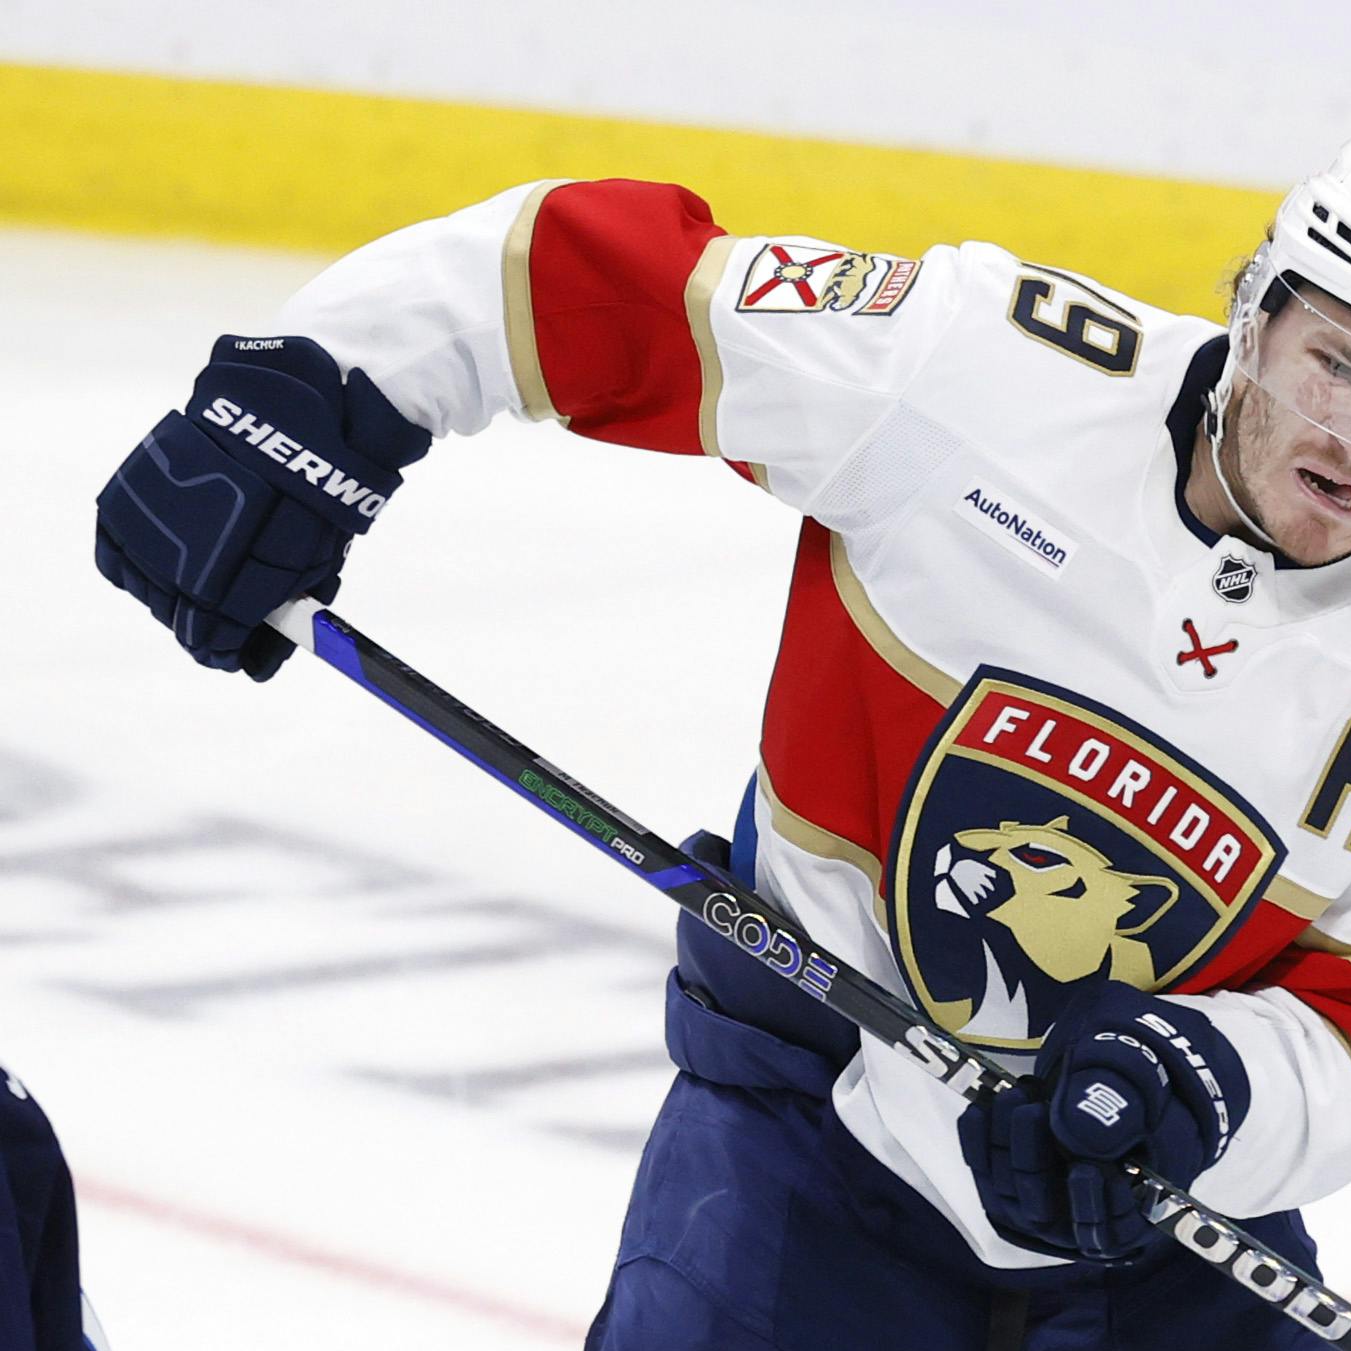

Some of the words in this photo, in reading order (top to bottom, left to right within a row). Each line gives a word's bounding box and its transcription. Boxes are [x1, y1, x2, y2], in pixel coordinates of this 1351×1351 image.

[1006, 260, 1142, 378] 9
[964, 488, 1067, 564] AutoNation
[1218, 572, 1249, 589] NHL
[518, 768, 618, 843] ENCRYPT
[610, 836, 646, 866] PRO
[982, 705, 1242, 884] FLORIDA
[702, 892, 838, 1003] CODE
